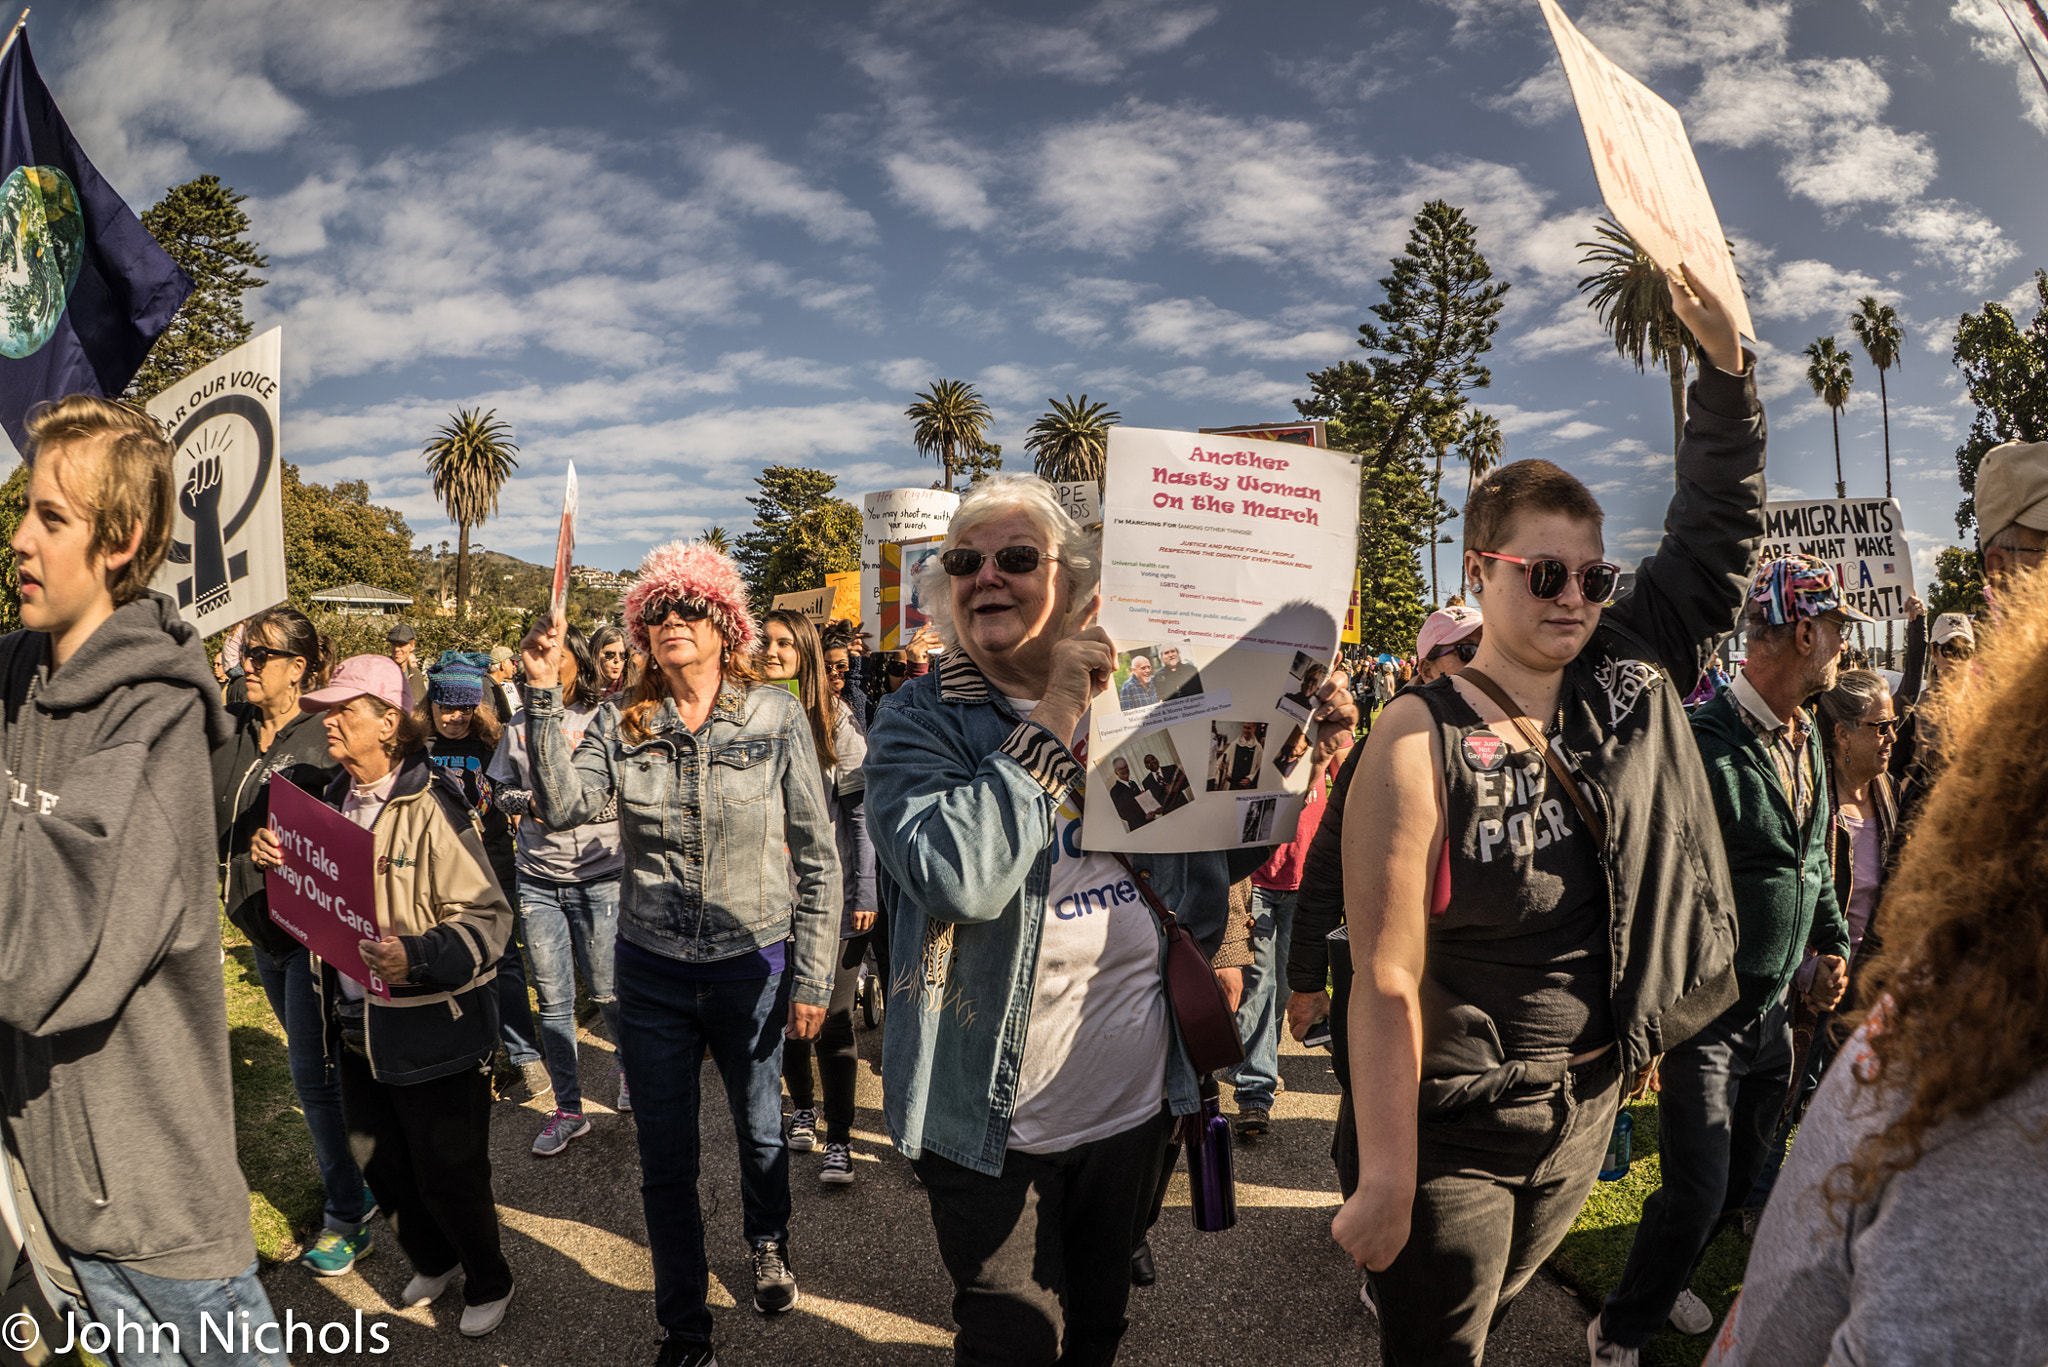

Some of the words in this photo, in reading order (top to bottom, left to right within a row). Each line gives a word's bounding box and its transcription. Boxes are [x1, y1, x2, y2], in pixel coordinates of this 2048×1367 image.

[190, 376, 226, 408] OUR
[230, 371, 277, 400] VOICE
[1188, 446, 1289, 471] Another
[1152, 467, 1230, 491] Nasty
[1237, 475, 1322, 503] Woman
[876, 491, 895, 502] Her
[904, 490, 934, 501] right
[1060, 484, 1087, 503] PE
[867, 507, 880, 520] You
[882, 511, 898, 521] may
[900, 508, 921, 519] shoot
[933, 510, 951, 521] with
[1153, 492, 1184, 511] On
[1191, 494, 1235, 514] the
[1241, 500, 1319, 526] March
[888, 522, 902, 532] your
[904, 522, 927, 530] words
[1765, 501, 1893, 539] MMIGRANTS
[864, 533, 875, 545] You
[1799, 538, 1846, 559] WHAT
[1855, 535, 1895, 557] MAKE
[1141, 570, 1160, 578] Voting
[1160, 581, 1179, 589] LGBTQ
[1179, 592, 1205, 600] Women's
[801, 596, 823, 615] will
[1129, 606, 1149, 614] Quality
[1148, 617, 1180, 625] Immigrants
[1167, 628, 1187, 636] Ending
[1187, 630, 1212, 638] domestic
[1468, 752, 1481, 760] Gay
[269, 812, 302, 857] Don't
[303, 837, 340, 881] Take
[304, 875, 332, 912] Our
[334, 896, 380, 943] Care.
